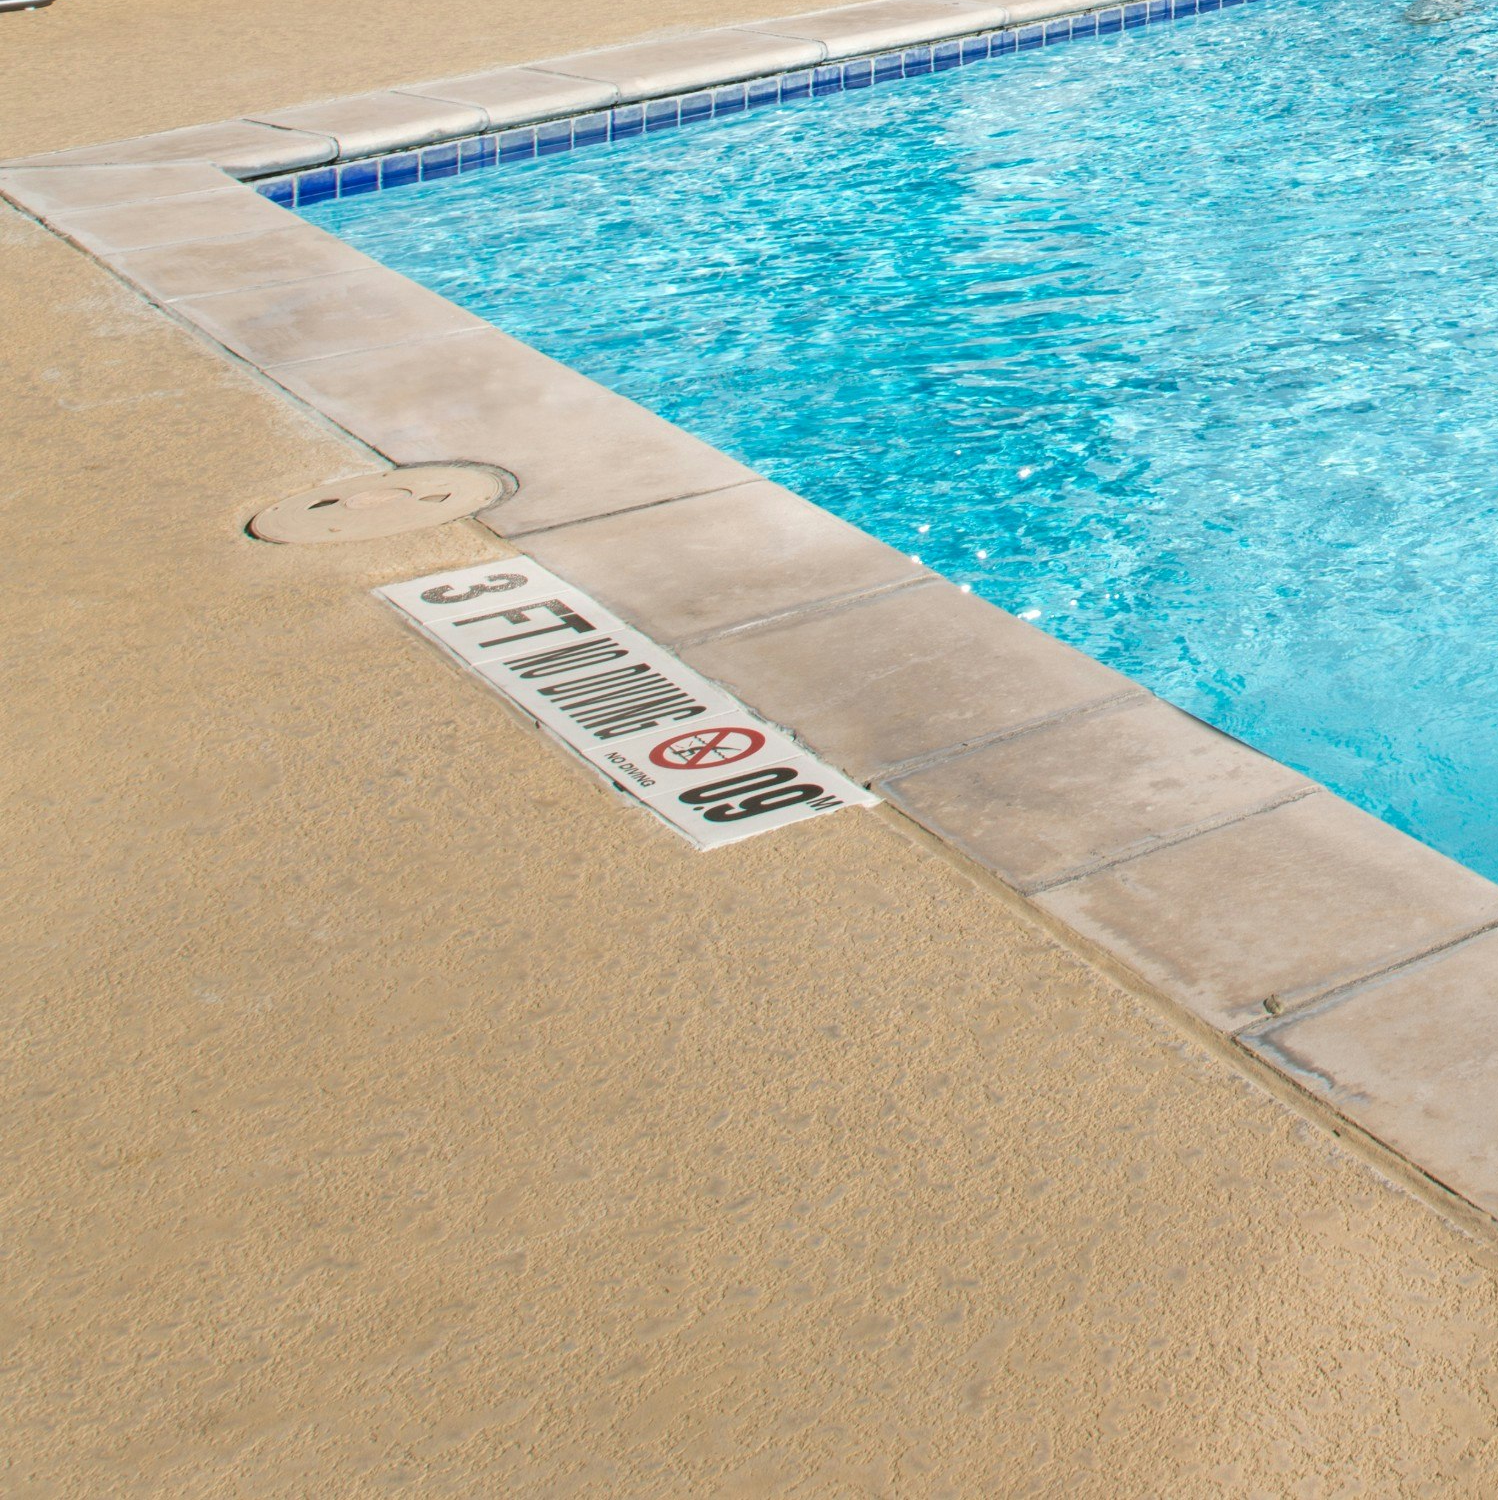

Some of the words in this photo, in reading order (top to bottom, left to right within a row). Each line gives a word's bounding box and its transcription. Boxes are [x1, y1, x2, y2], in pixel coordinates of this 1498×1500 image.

[420, 573, 528, 604] 3
[452, 598, 597, 649] FT
[503, 637, 629, 679] NO
[537, 663, 708, 740] DIVING
[605, 751, 626, 764] NO
[619, 761, 656, 788] DIVING
